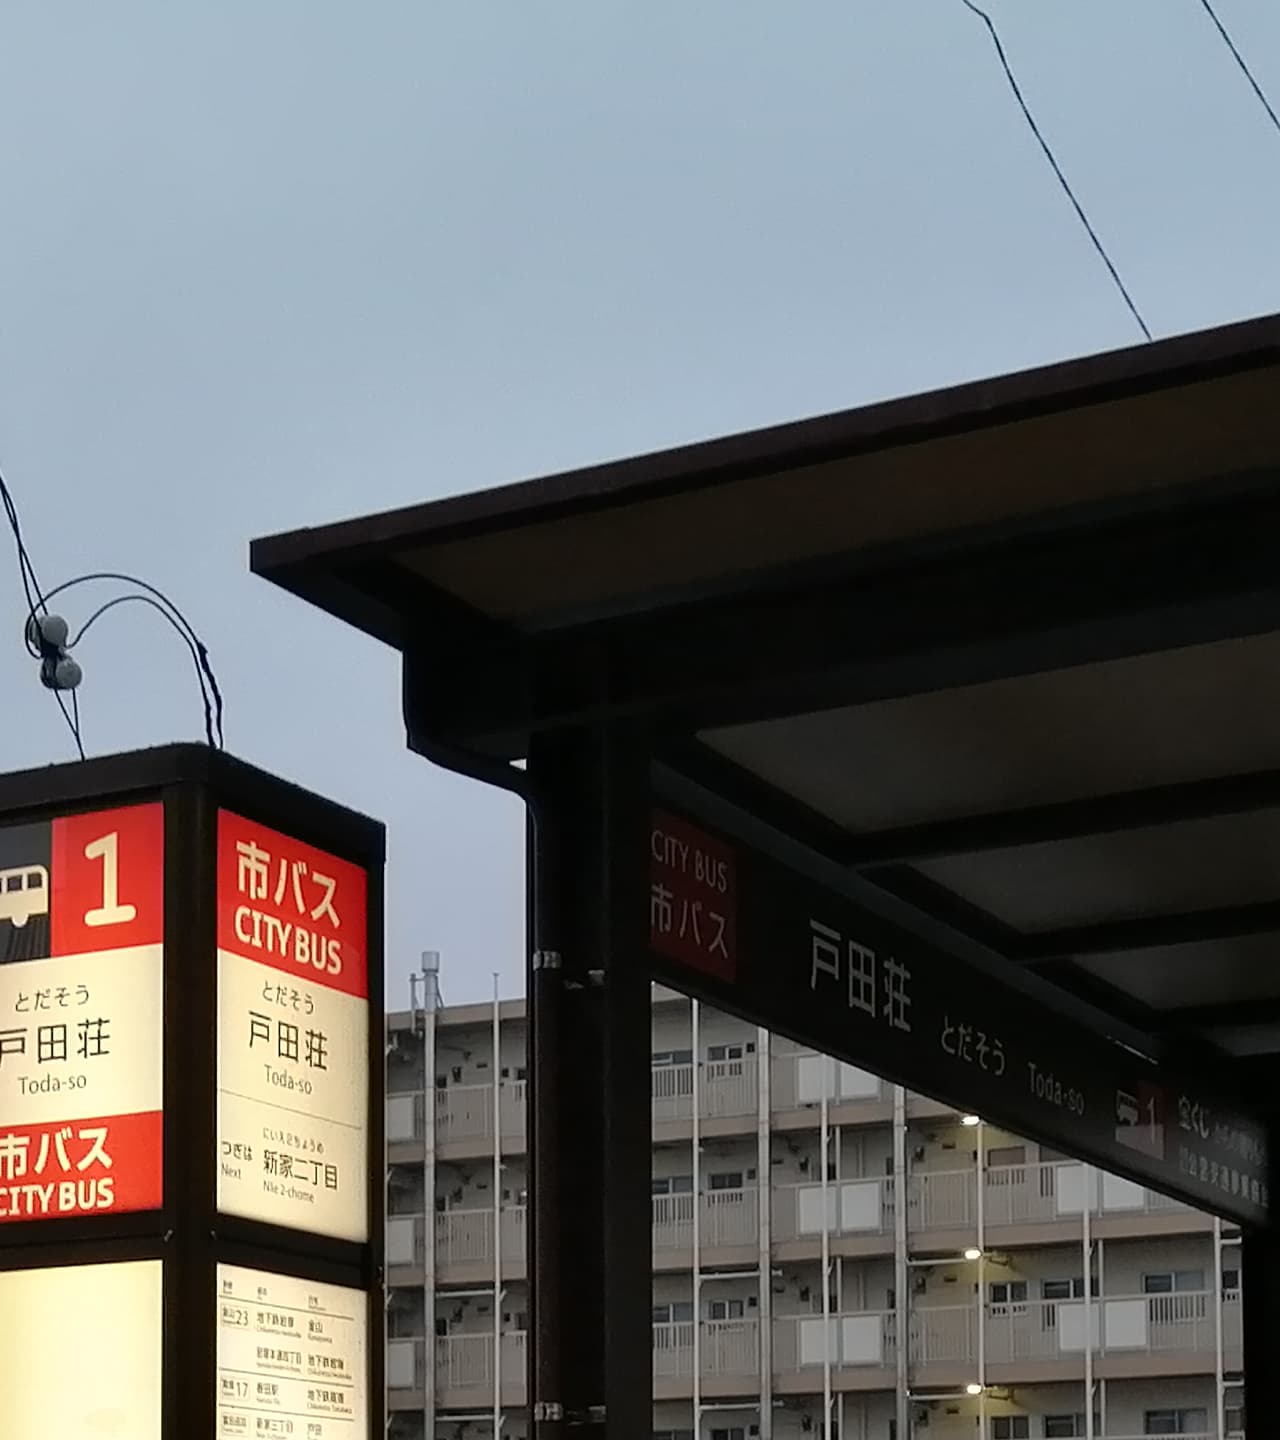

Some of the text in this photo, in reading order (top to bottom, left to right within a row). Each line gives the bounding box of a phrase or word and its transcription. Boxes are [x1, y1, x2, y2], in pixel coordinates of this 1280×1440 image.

[83, 831, 137, 927] 1
[236, 839, 341, 929] 市バス
[651, 829, 728, 894] CITY BUS
[234, 905, 343, 976] CITY BUS
[650, 882, 729, 959] 市バス
[15, 984, 91, 1013] とだそう
[261, 980, 317, 1016] とだそう
[809, 917, 912, 1033] 戸田荘
[248, 1009, 329, 1072] 戸田荘
[941, 1015, 1006, 1076] とだそう
[17, 1071, 88, 1096] Toda-so
[263, 1063, 314, 1095] Toda-so
[1027, 1060, 1087, 1117] Toda-so
[60, 1177, 115, 1210] BUS
[263, 1149, 338, 1191] 新家二丁目
